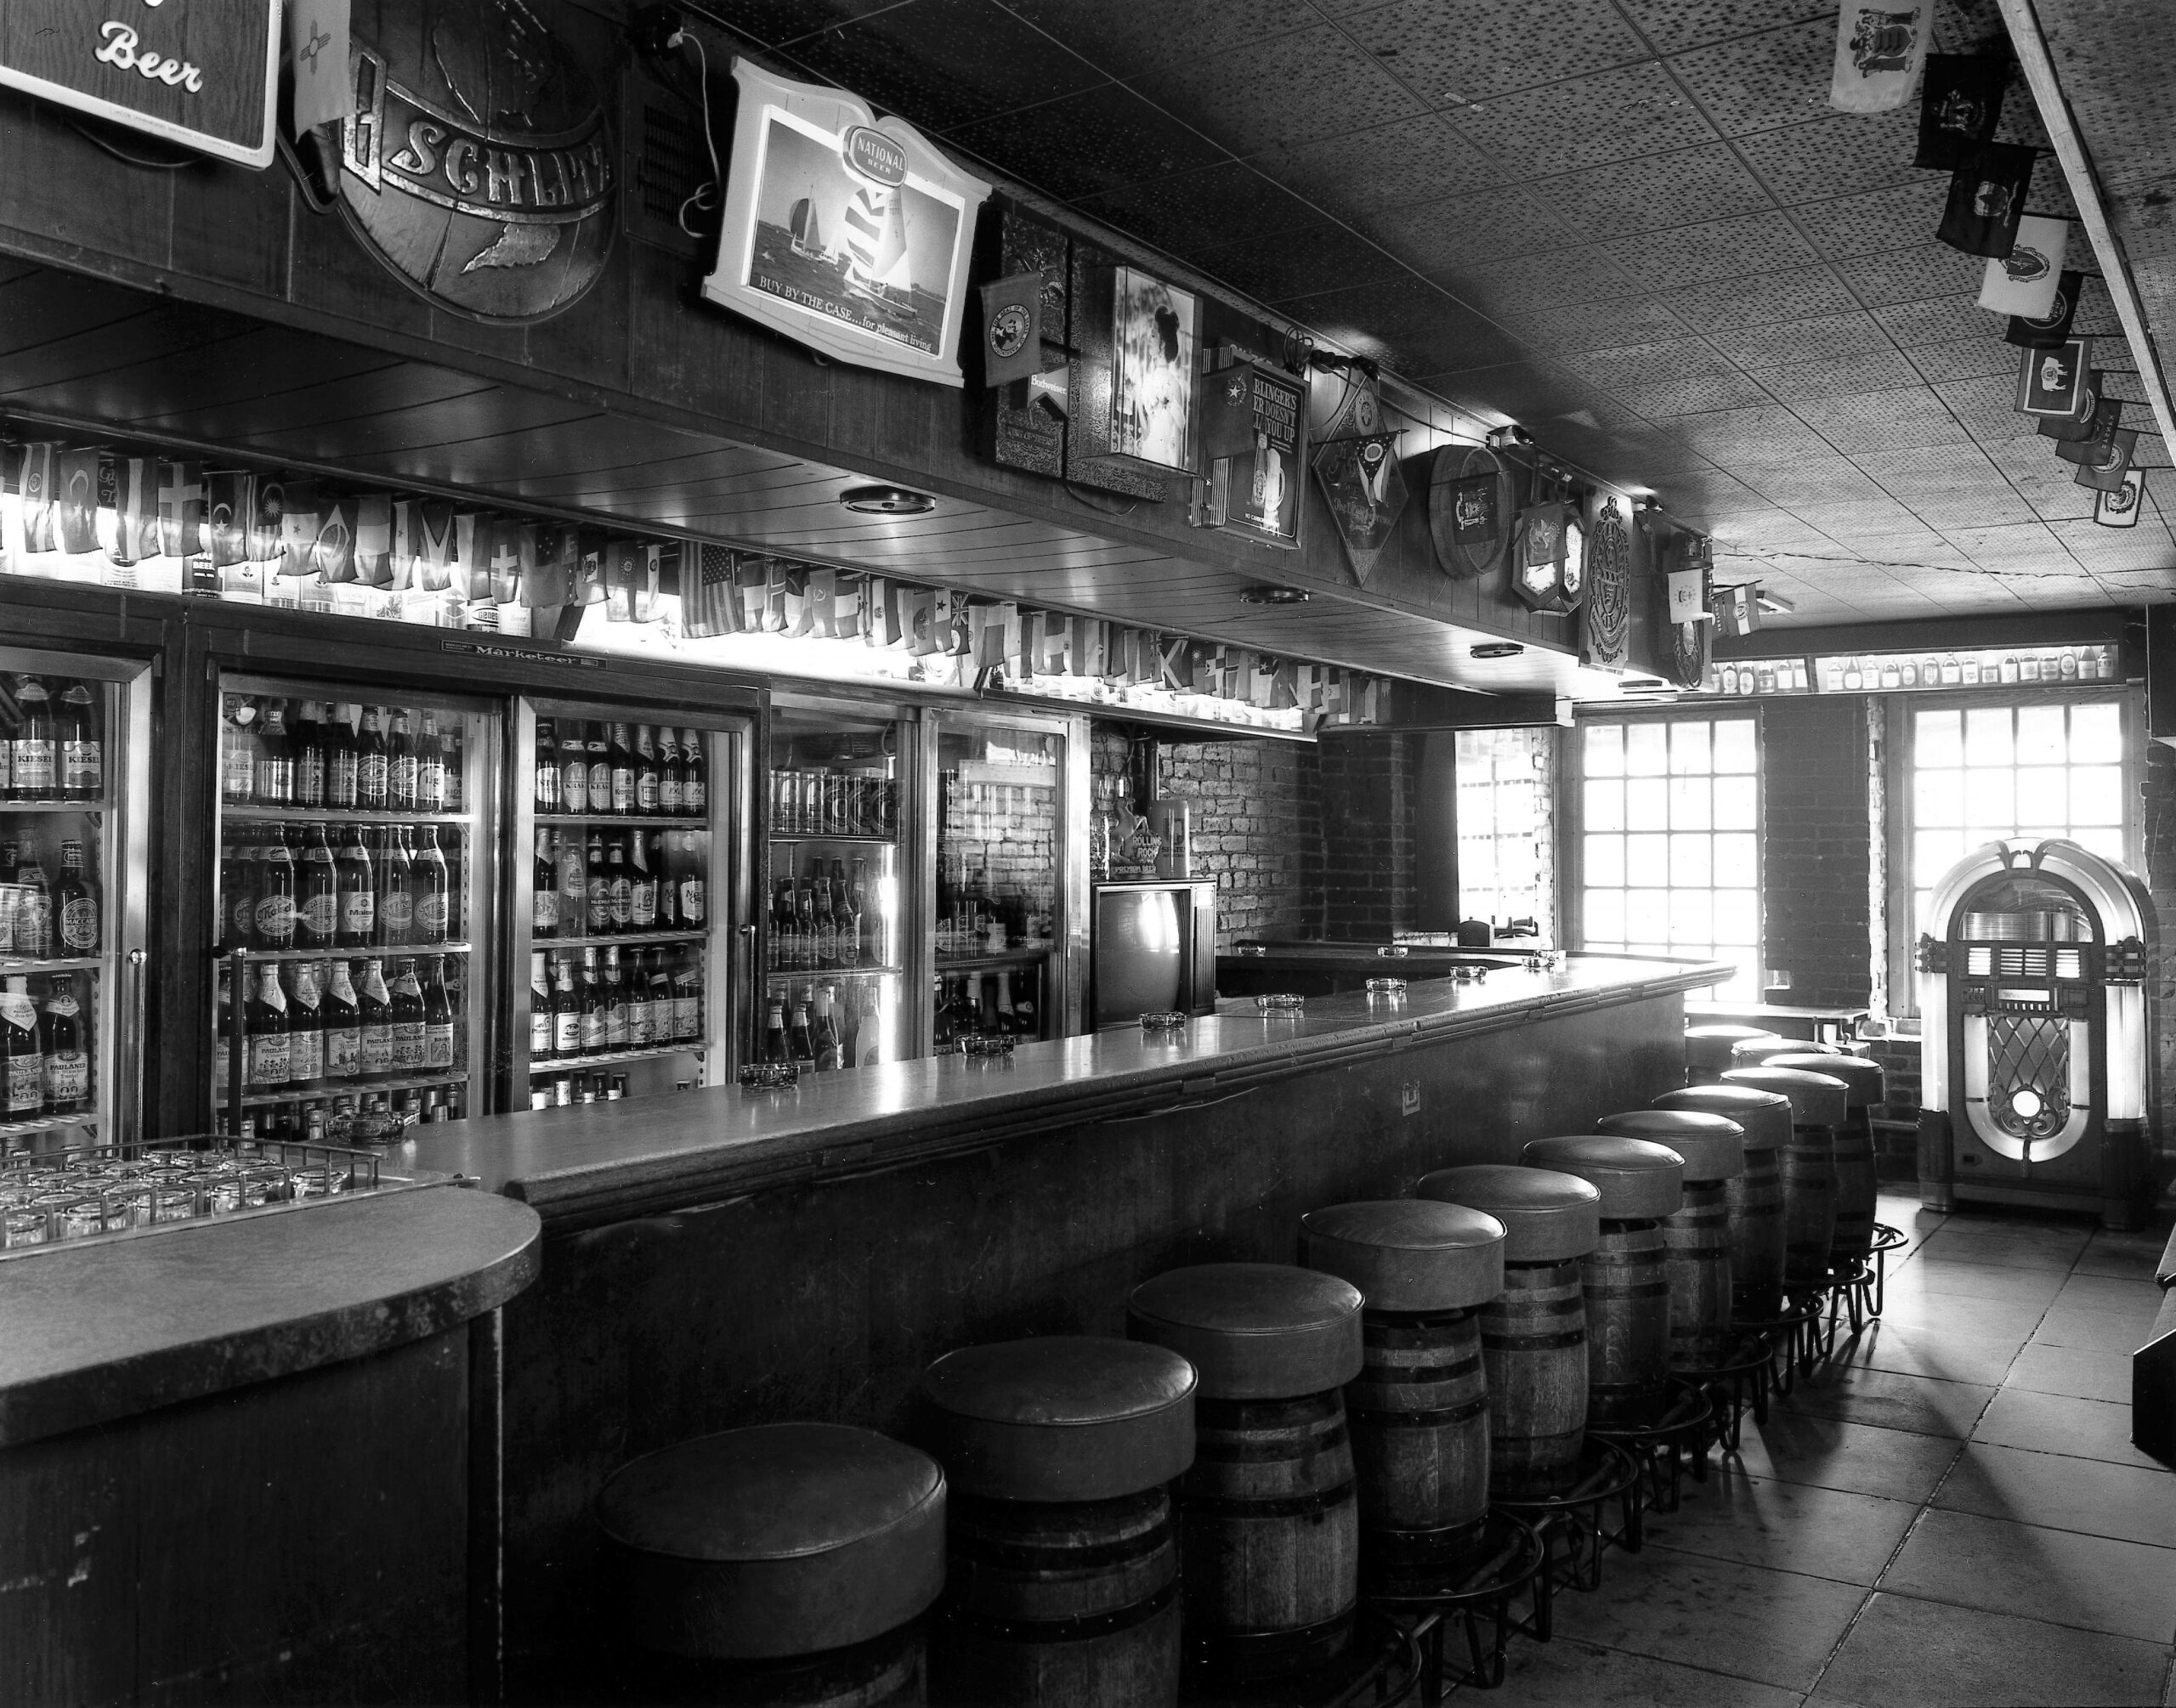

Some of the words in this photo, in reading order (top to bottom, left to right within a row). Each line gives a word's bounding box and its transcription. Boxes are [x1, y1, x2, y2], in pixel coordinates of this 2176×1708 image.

[94, 20, 203, 93] Beer
[857, 136, 904, 172] NATIONAL
[867, 158, 892, 175] BEER
[759, 275, 783, 294] BUY
[785, 285, 802, 301] BY
[802, 291, 824, 311] THE
[876, 322, 910, 342] pleasant
[910, 334, 932, 353] living
[1253, 378, 1297, 410] BLINGER'S
[1265, 399, 1296, 427] DOESN'T
[1266, 417, 1283, 438] YOU
[1284, 425, 1295, 444] UP
[1133, 834, 1163, 846] ROLLING
[1137, 847, 1159, 857] ROCK
